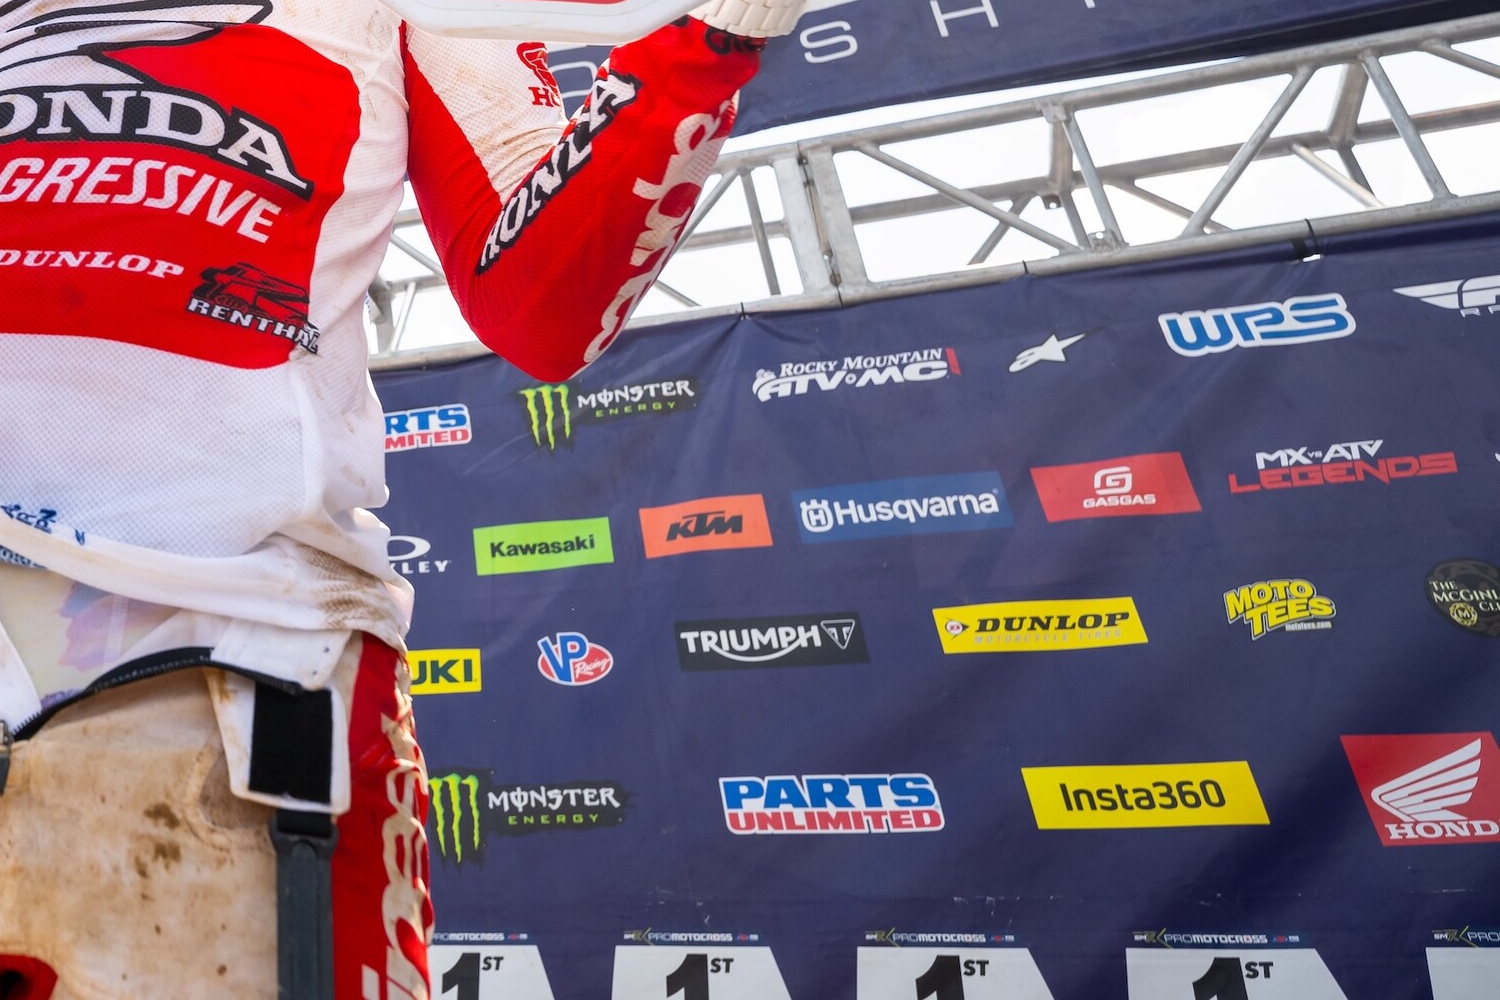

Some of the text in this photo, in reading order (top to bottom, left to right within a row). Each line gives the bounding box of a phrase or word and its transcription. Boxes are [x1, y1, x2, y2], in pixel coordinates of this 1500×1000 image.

[1162, 295, 1354, 355] WPS
[779, 348, 943, 378] ROCKY MOUNTAIN
[576, 379, 696, 409] MONSTER
[384, 406, 469, 435] RTS
[595, 401, 676, 418] ENERGY
[384, 429, 470, 450] MITED
[1228, 451, 1458, 494] LEGENDS
[833, 490, 996, 528] Husqvarna
[1083, 493, 1156, 509] GASGAS
[665, 510, 744, 542] KTM
[490, 534, 595, 559] Kawasaki
[1429, 580, 1458, 591] THE
[1224, 579, 1315, 621] MOTO
[975, 612, 1130, 633] DUNLOP
[1245, 597, 1335, 639] TEES
[1285, 620, 1332, 632] mototees.com
[680, 620, 822, 663] TRIUMPH
[974, 629, 1122, 645] MOTORCYCLE TIRES
[411, 658, 473, 685] UKI
[538, 632, 590, 684] VP
[488, 784, 620, 811] MONSTER
[722, 775, 940, 811] PARTS
[1059, 778, 1226, 813] Insta360
[508, 813, 600, 825] ENERGY
[728, 809, 942, 832] UNLIMITED
[1383, 820, 1500, 840] HOND
